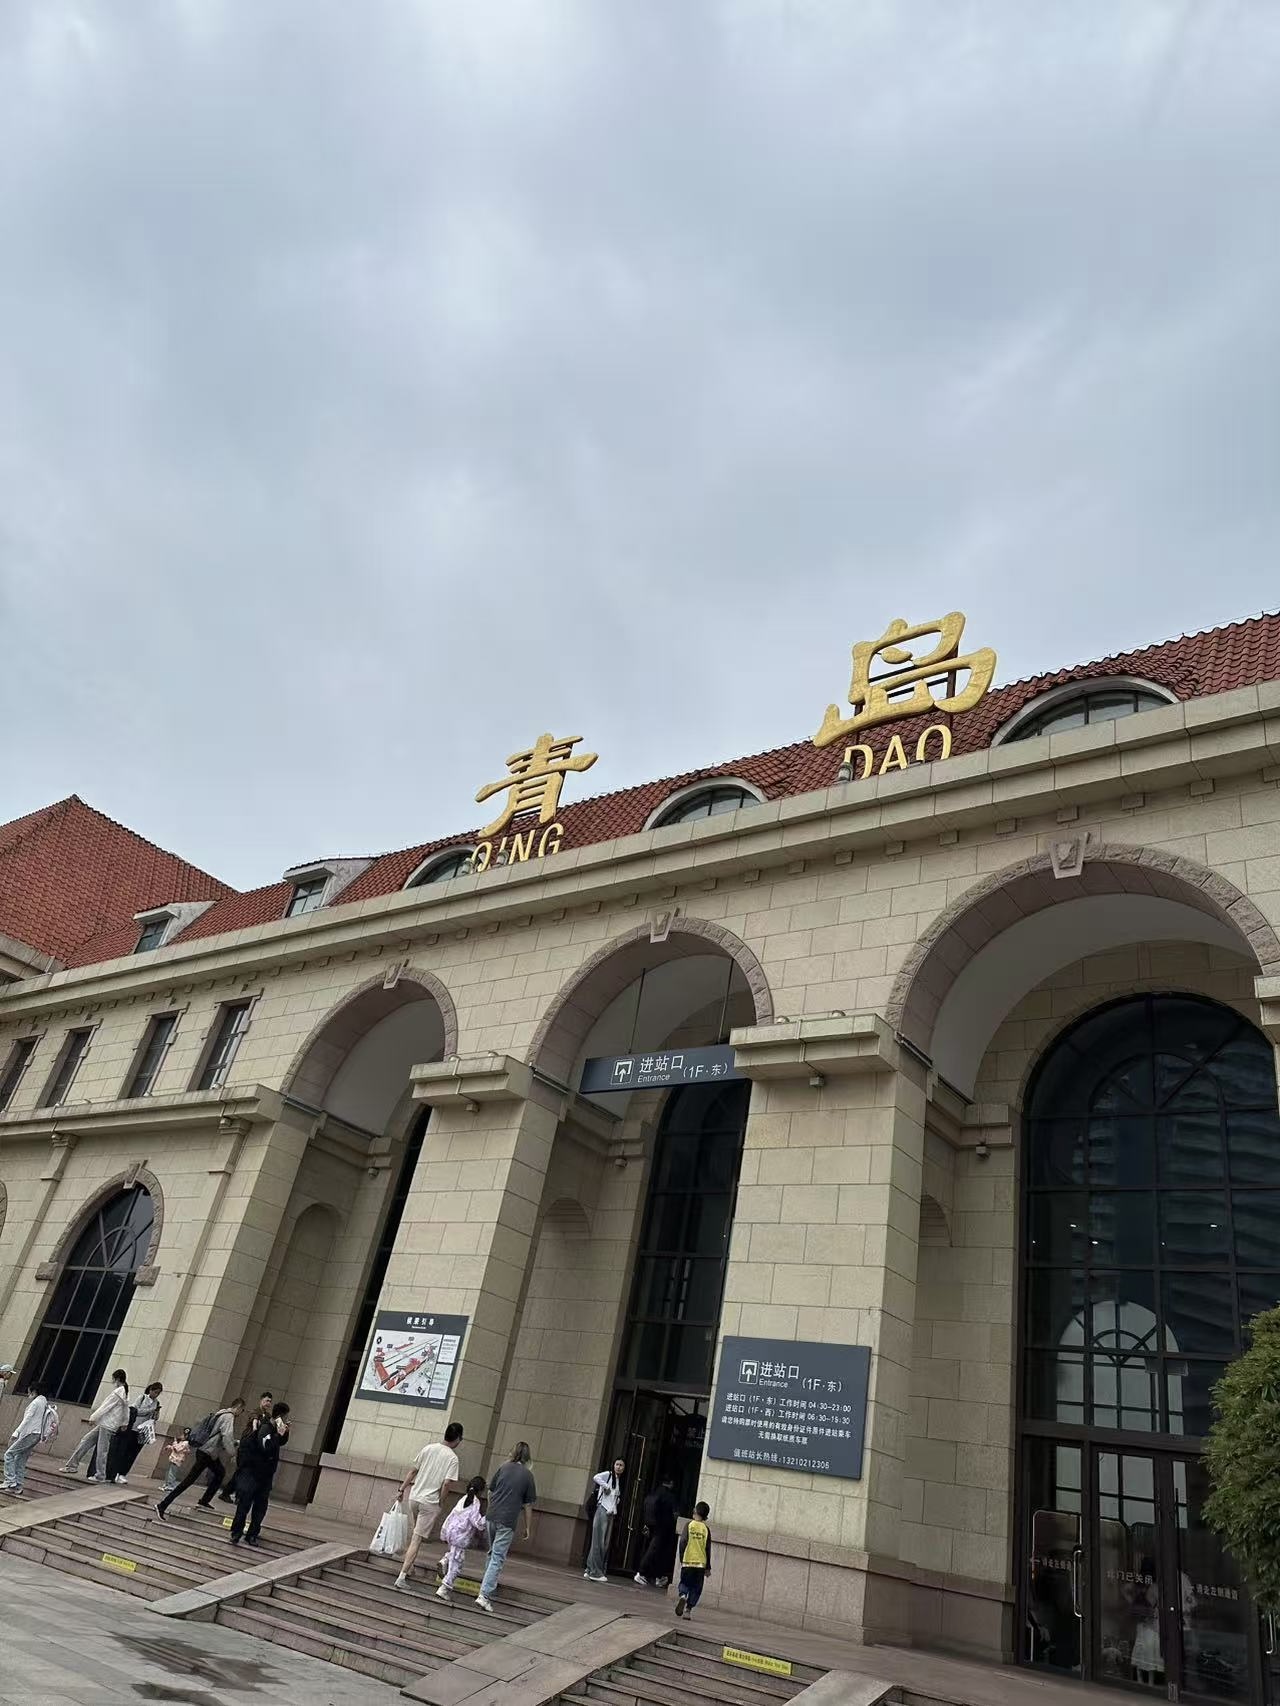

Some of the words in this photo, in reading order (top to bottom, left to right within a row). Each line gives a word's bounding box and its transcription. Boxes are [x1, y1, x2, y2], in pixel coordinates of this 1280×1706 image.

[474, 732, 599, 840] 青
[813, 611, 998, 748] 岛
[843, 724, 952, 780] DAO
[639, 1055, 684, 1074] 进站口
[637, 1073, 671, 1083] Entrance
[759, 1361, 800, 1380] 进站口
[759, 1378, 789, 1389] Entrance
